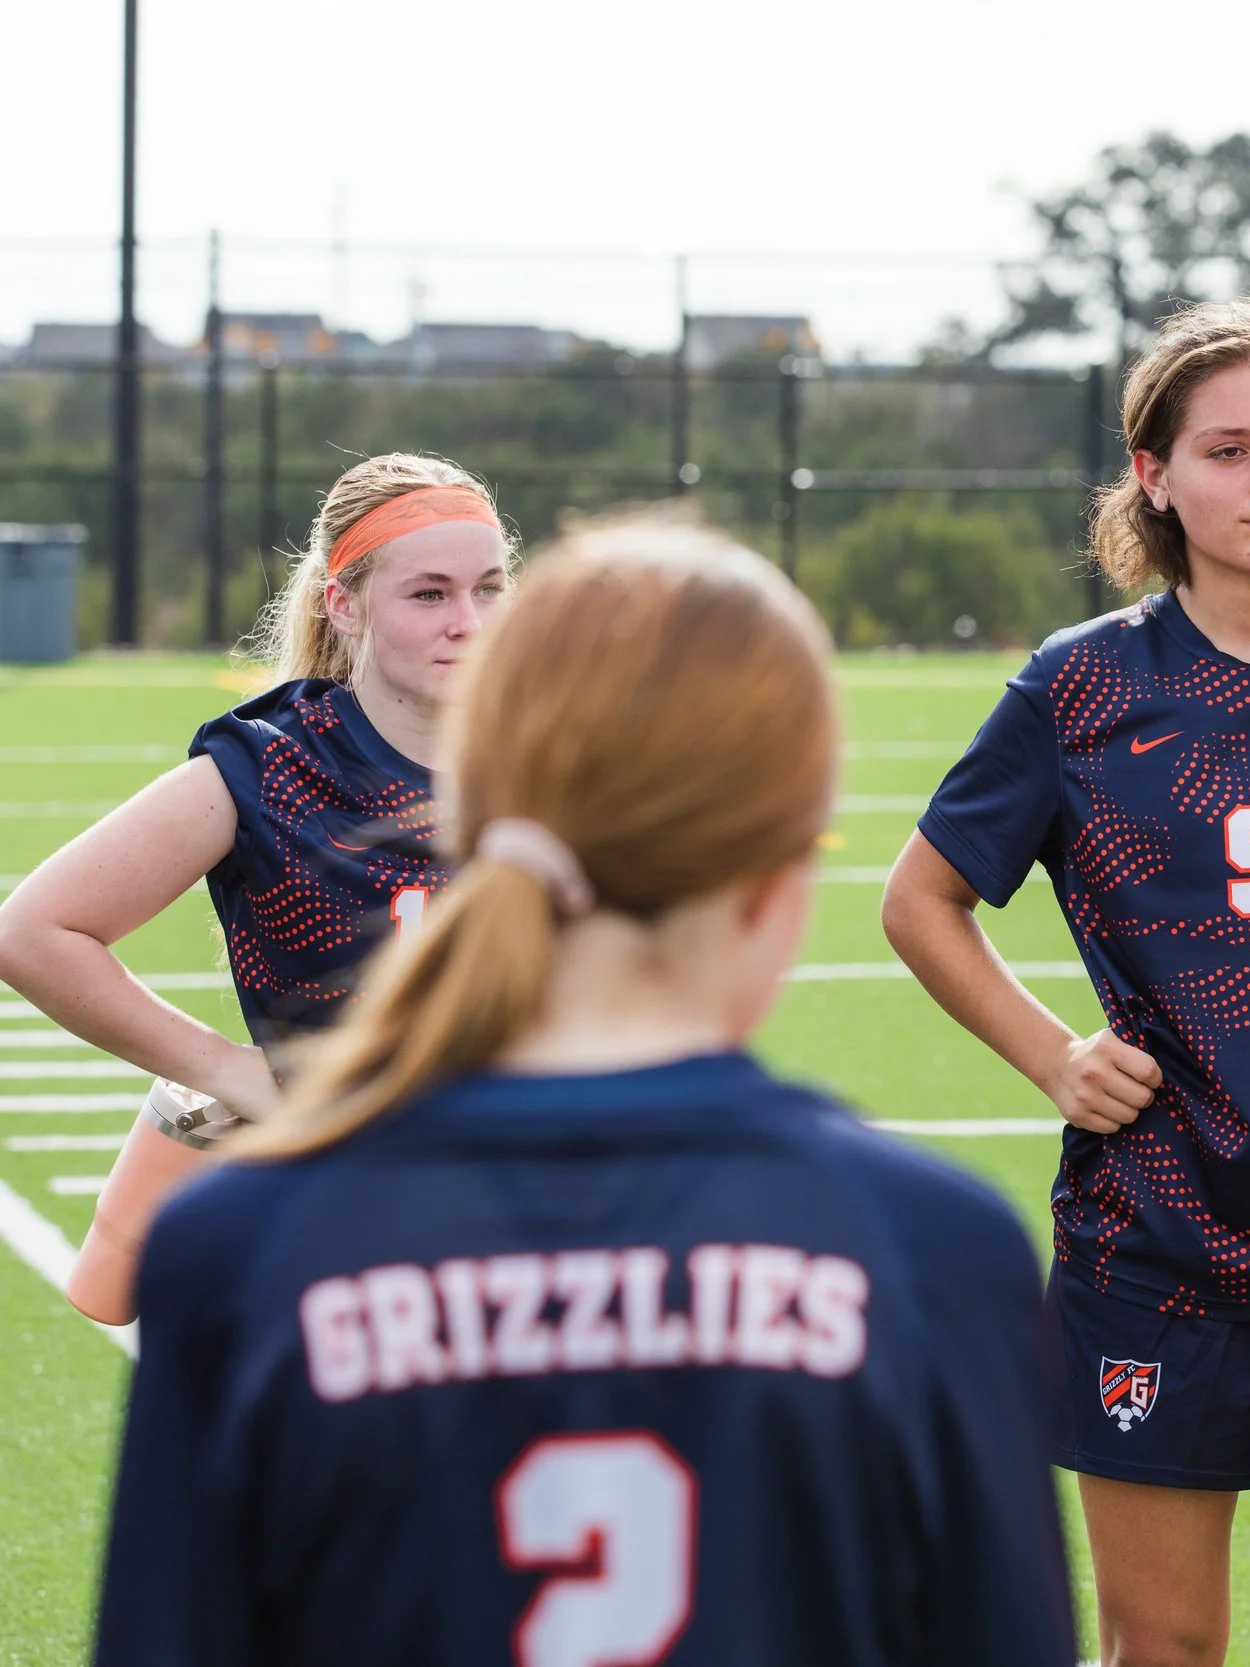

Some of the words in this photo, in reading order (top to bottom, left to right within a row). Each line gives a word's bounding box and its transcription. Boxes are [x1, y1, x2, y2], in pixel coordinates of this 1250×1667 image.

[300, 1243, 869, 1402] GRIZZLIES
[1102, 1371, 1126, 1396] GRIZZLY
[1126, 1364, 1136, 1375] FC
[1130, 1375, 1149, 1410] G
[496, 1430, 698, 1667] 2
